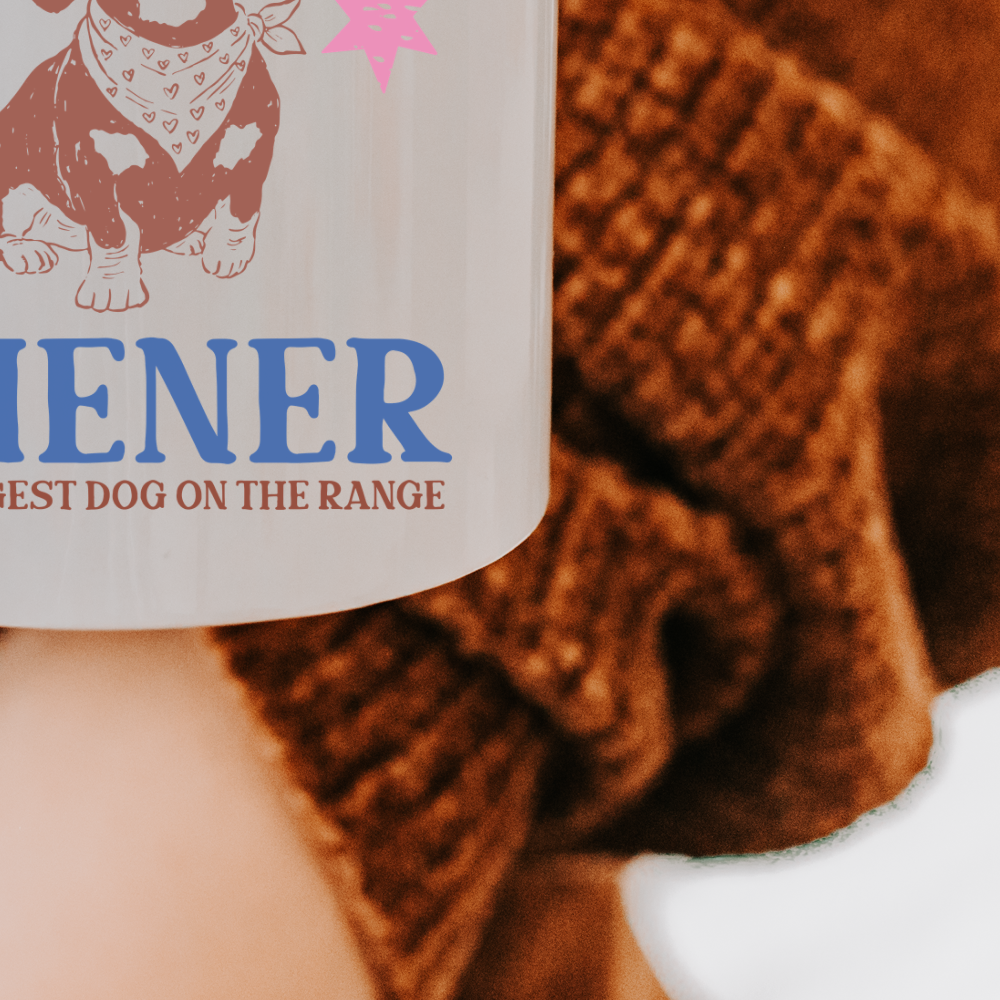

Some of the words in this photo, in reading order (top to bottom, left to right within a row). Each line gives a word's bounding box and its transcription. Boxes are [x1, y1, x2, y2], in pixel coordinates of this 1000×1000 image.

[85, 480, 167, 511] DOG
[176, 480, 228, 511] ON
[236, 480, 310, 510] THE
[318, 480, 446, 511] RANGE
